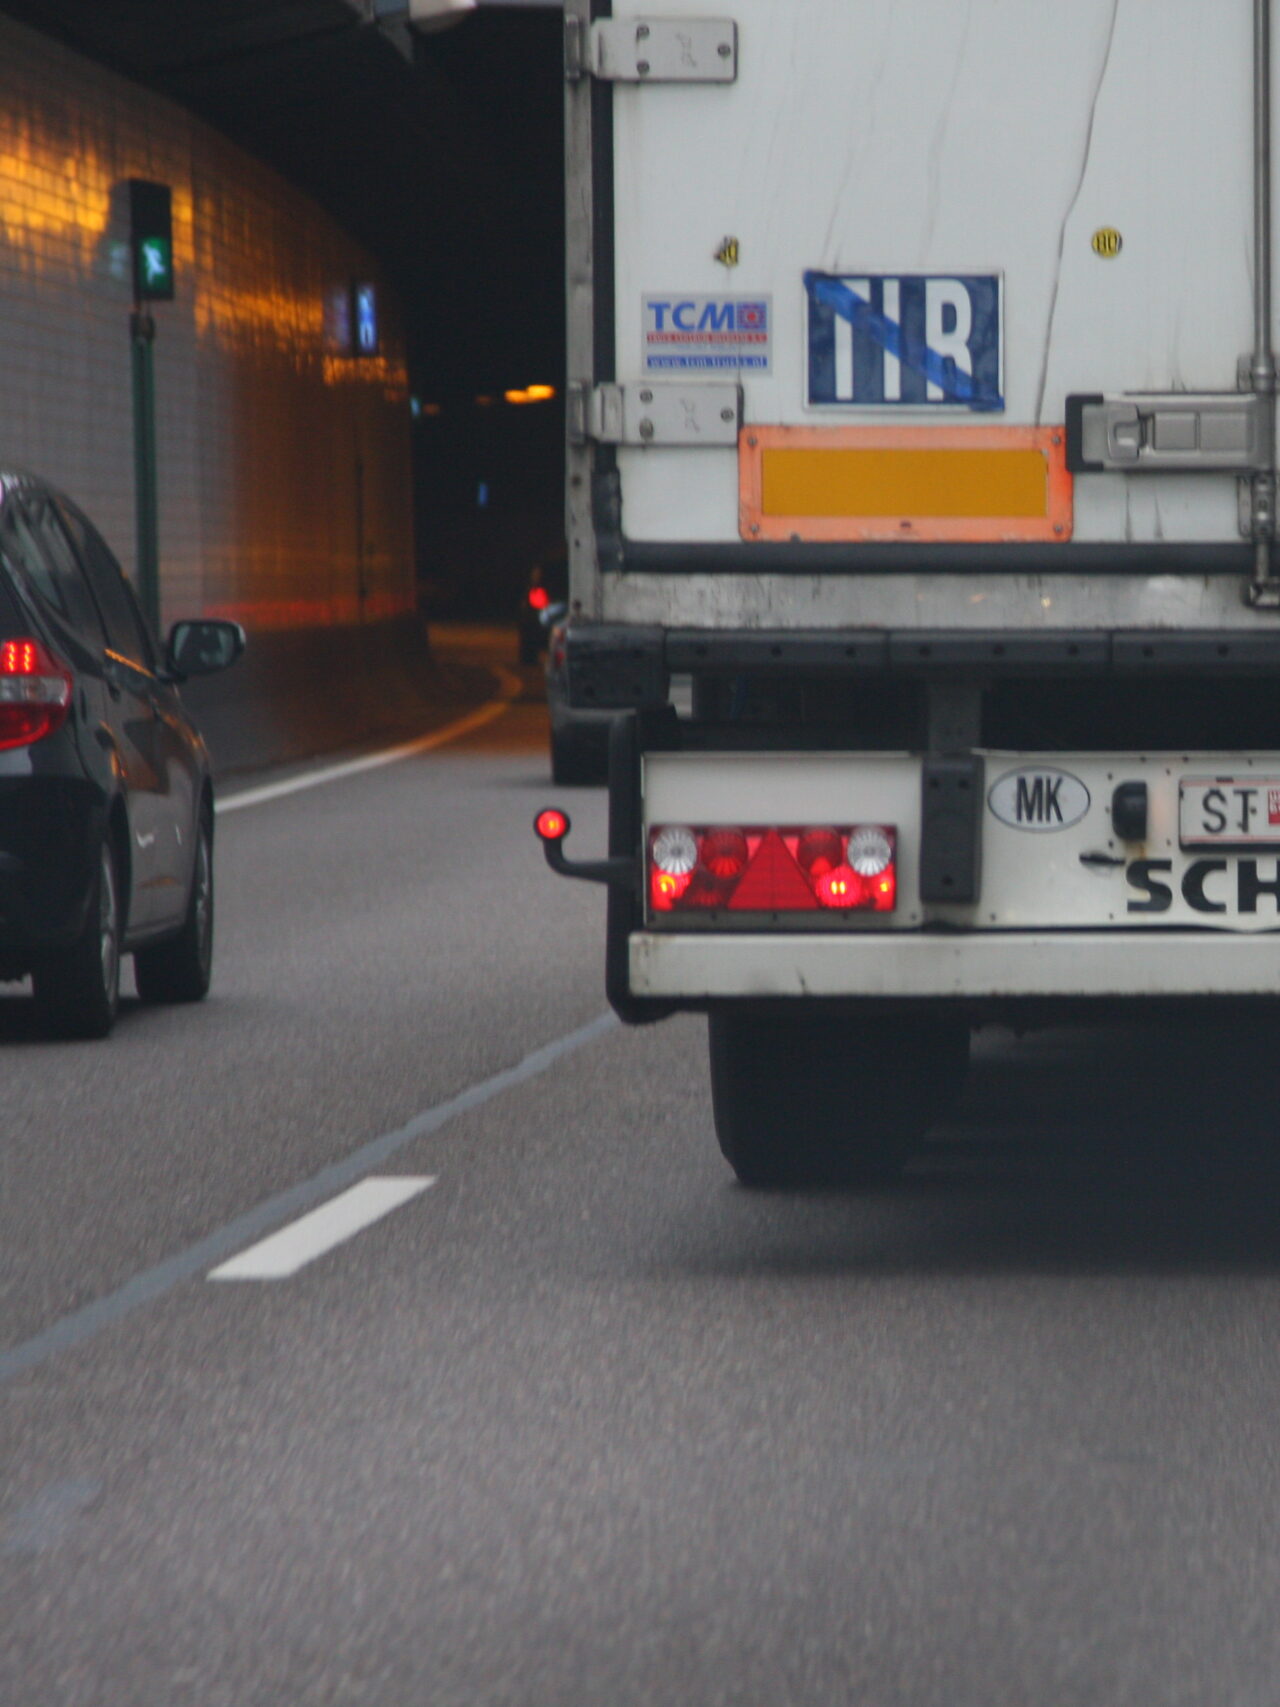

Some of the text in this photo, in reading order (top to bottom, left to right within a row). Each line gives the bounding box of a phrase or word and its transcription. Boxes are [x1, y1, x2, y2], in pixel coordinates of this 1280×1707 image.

[647, 302, 735, 331] TCM
[816, 278, 974, 401] TIR
[1016, 775, 1064, 824] MK
